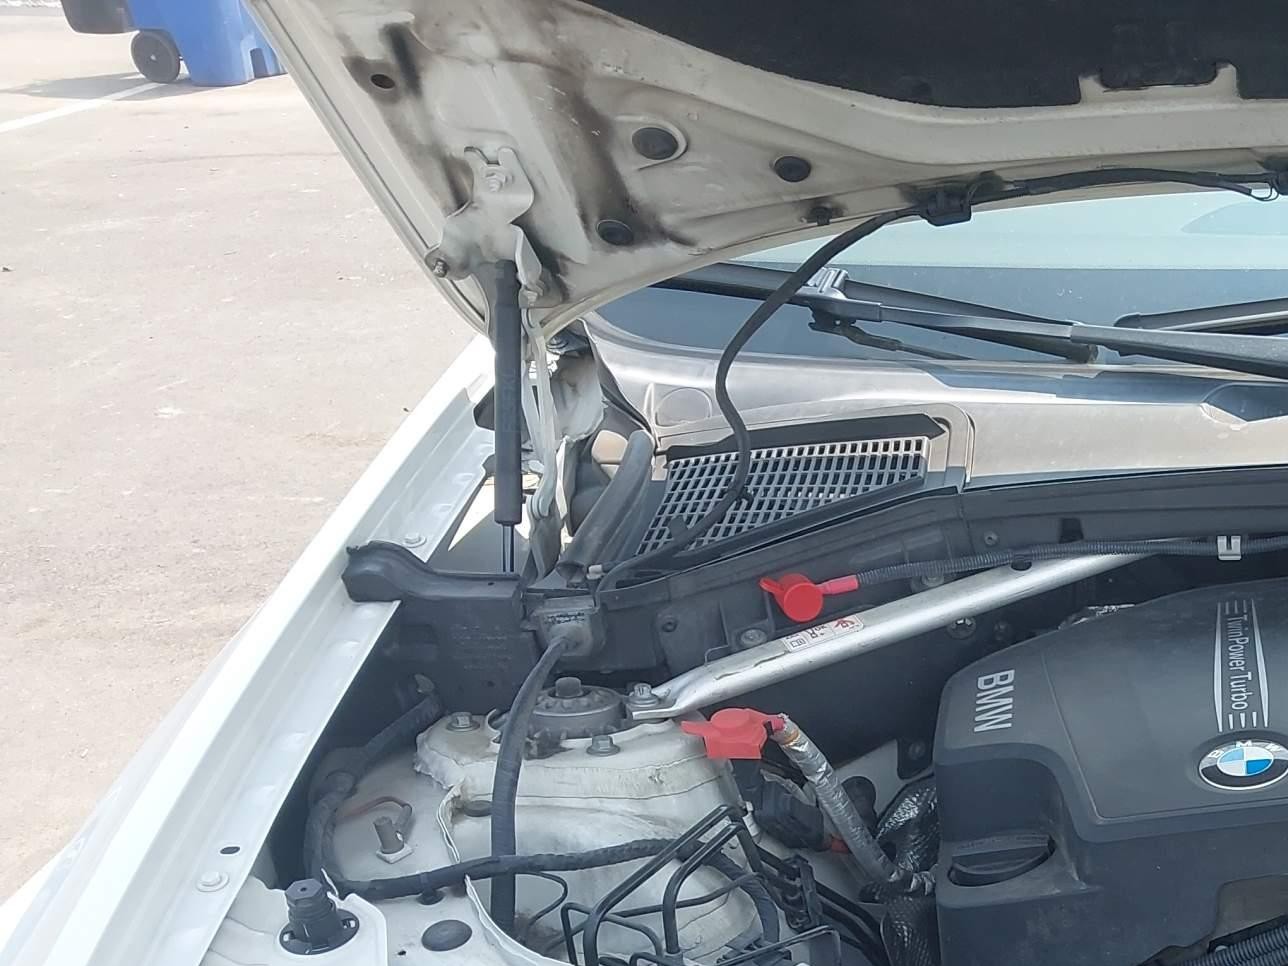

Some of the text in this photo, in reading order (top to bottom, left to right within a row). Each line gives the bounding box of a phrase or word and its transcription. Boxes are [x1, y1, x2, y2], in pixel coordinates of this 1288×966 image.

[973, 669, 1015, 733] BMW
[1227, 614, 1253, 710] TwinPower Turbo
